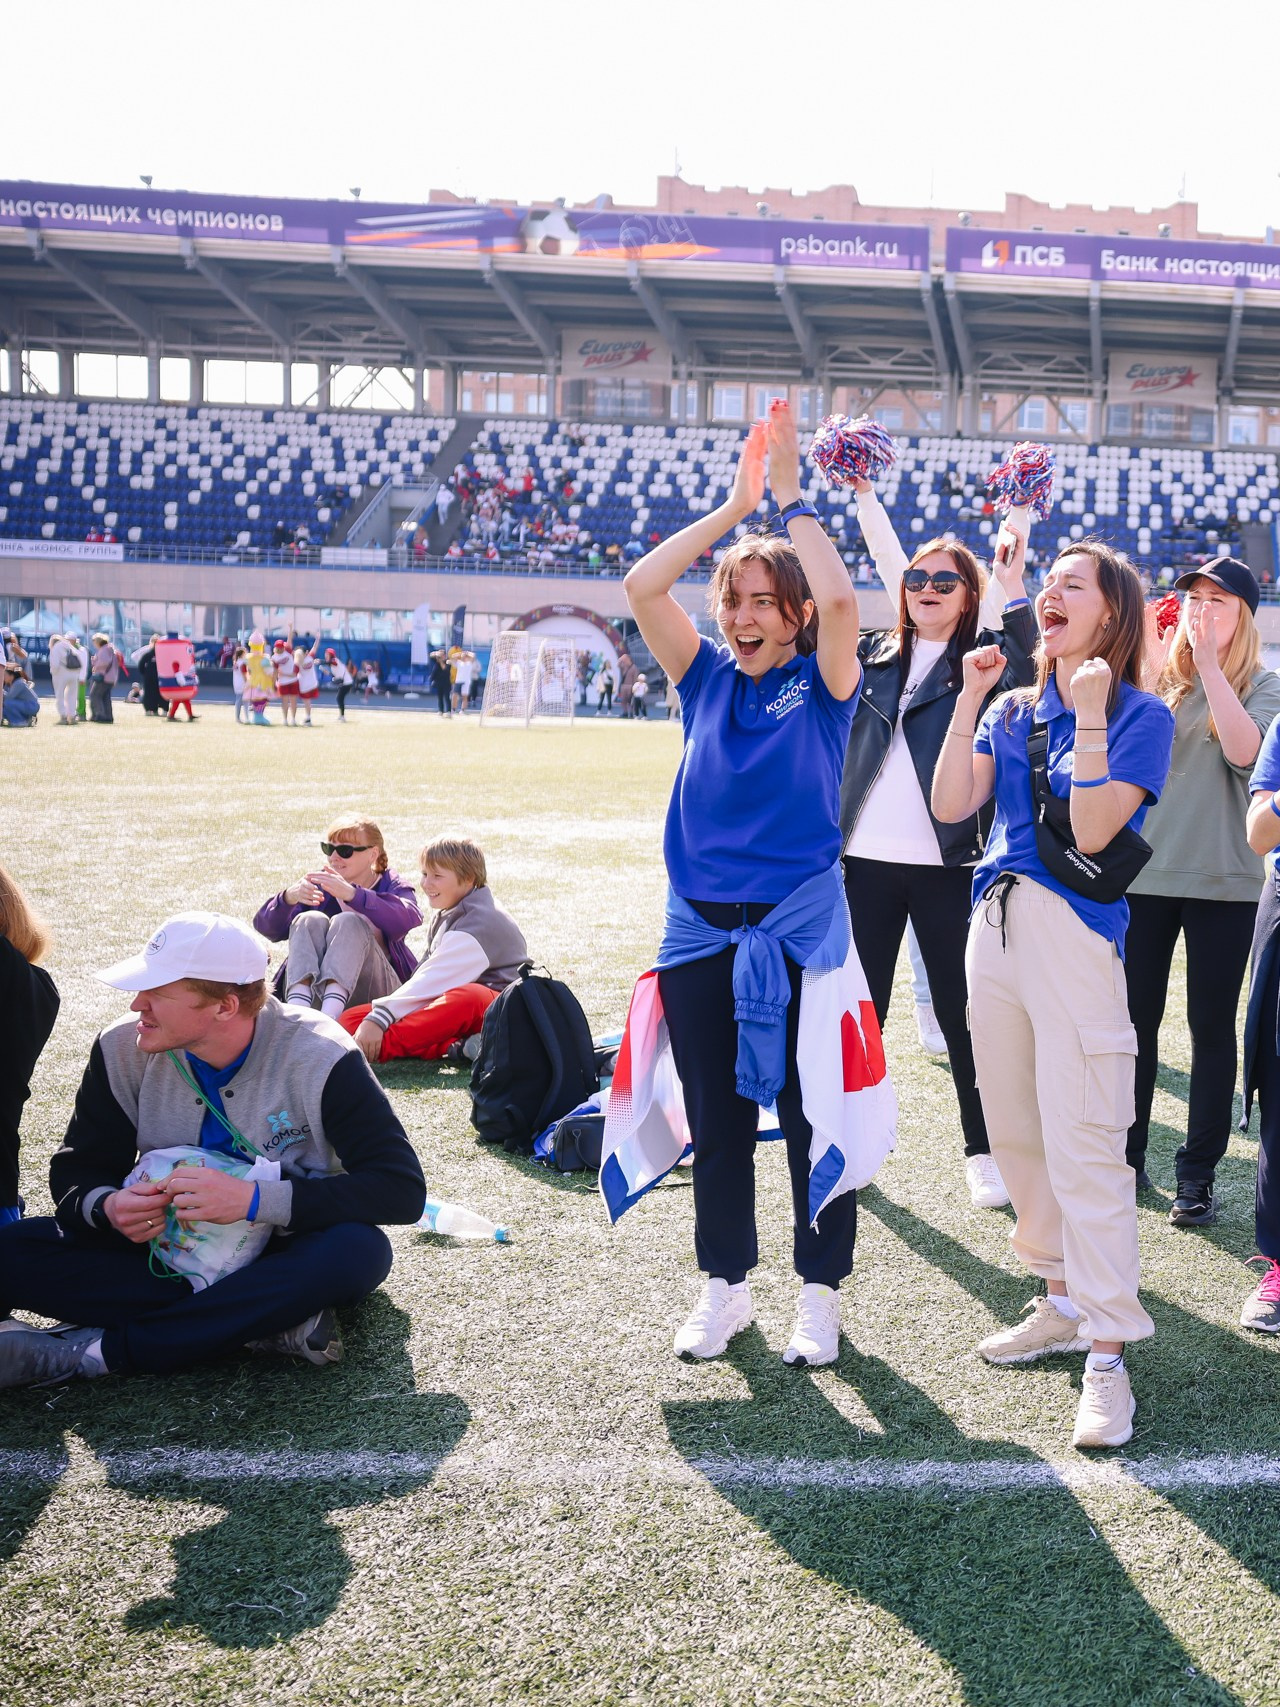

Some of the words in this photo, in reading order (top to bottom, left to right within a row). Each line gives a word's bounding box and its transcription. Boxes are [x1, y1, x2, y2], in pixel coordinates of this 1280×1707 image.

[0, 199, 141, 225] настоящих
[147, 207, 284, 231] чемпионов
[780, 233, 898, 258] psbank.ru
[1014, 245, 1066, 266] ПСБ
[1100, 249, 1159, 272] Банк
[766, 680, 809, 713] КОМОС
[1064, 848, 1096, 880] Удмуртии
[262, 1124, 312, 1152] КОМОС
